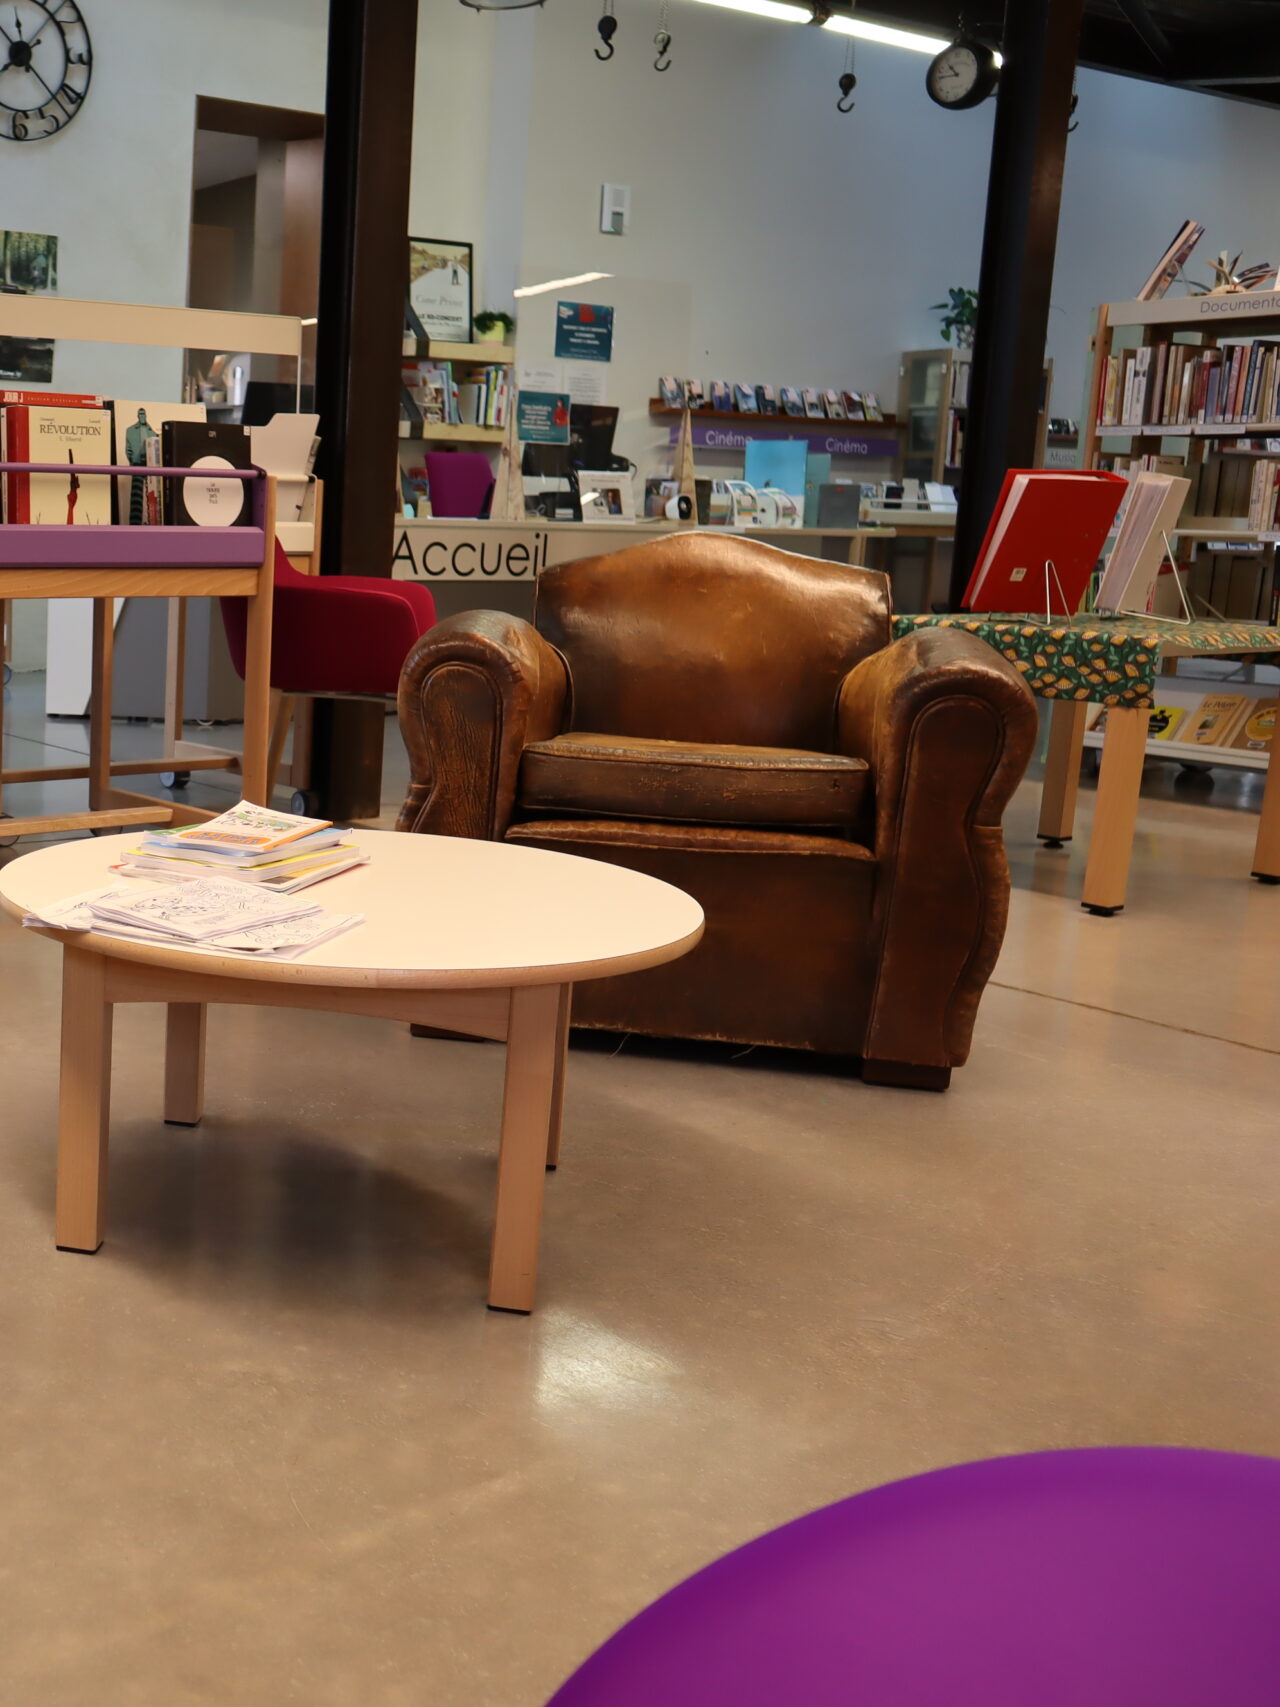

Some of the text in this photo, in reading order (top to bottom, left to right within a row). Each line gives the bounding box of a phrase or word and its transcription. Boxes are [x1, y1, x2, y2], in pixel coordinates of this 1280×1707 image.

[39, 422, 101, 436] RÉVOLUTION
[825, 437, 868, 455] Cinéma
[392, 530, 548, 577] Accueil
